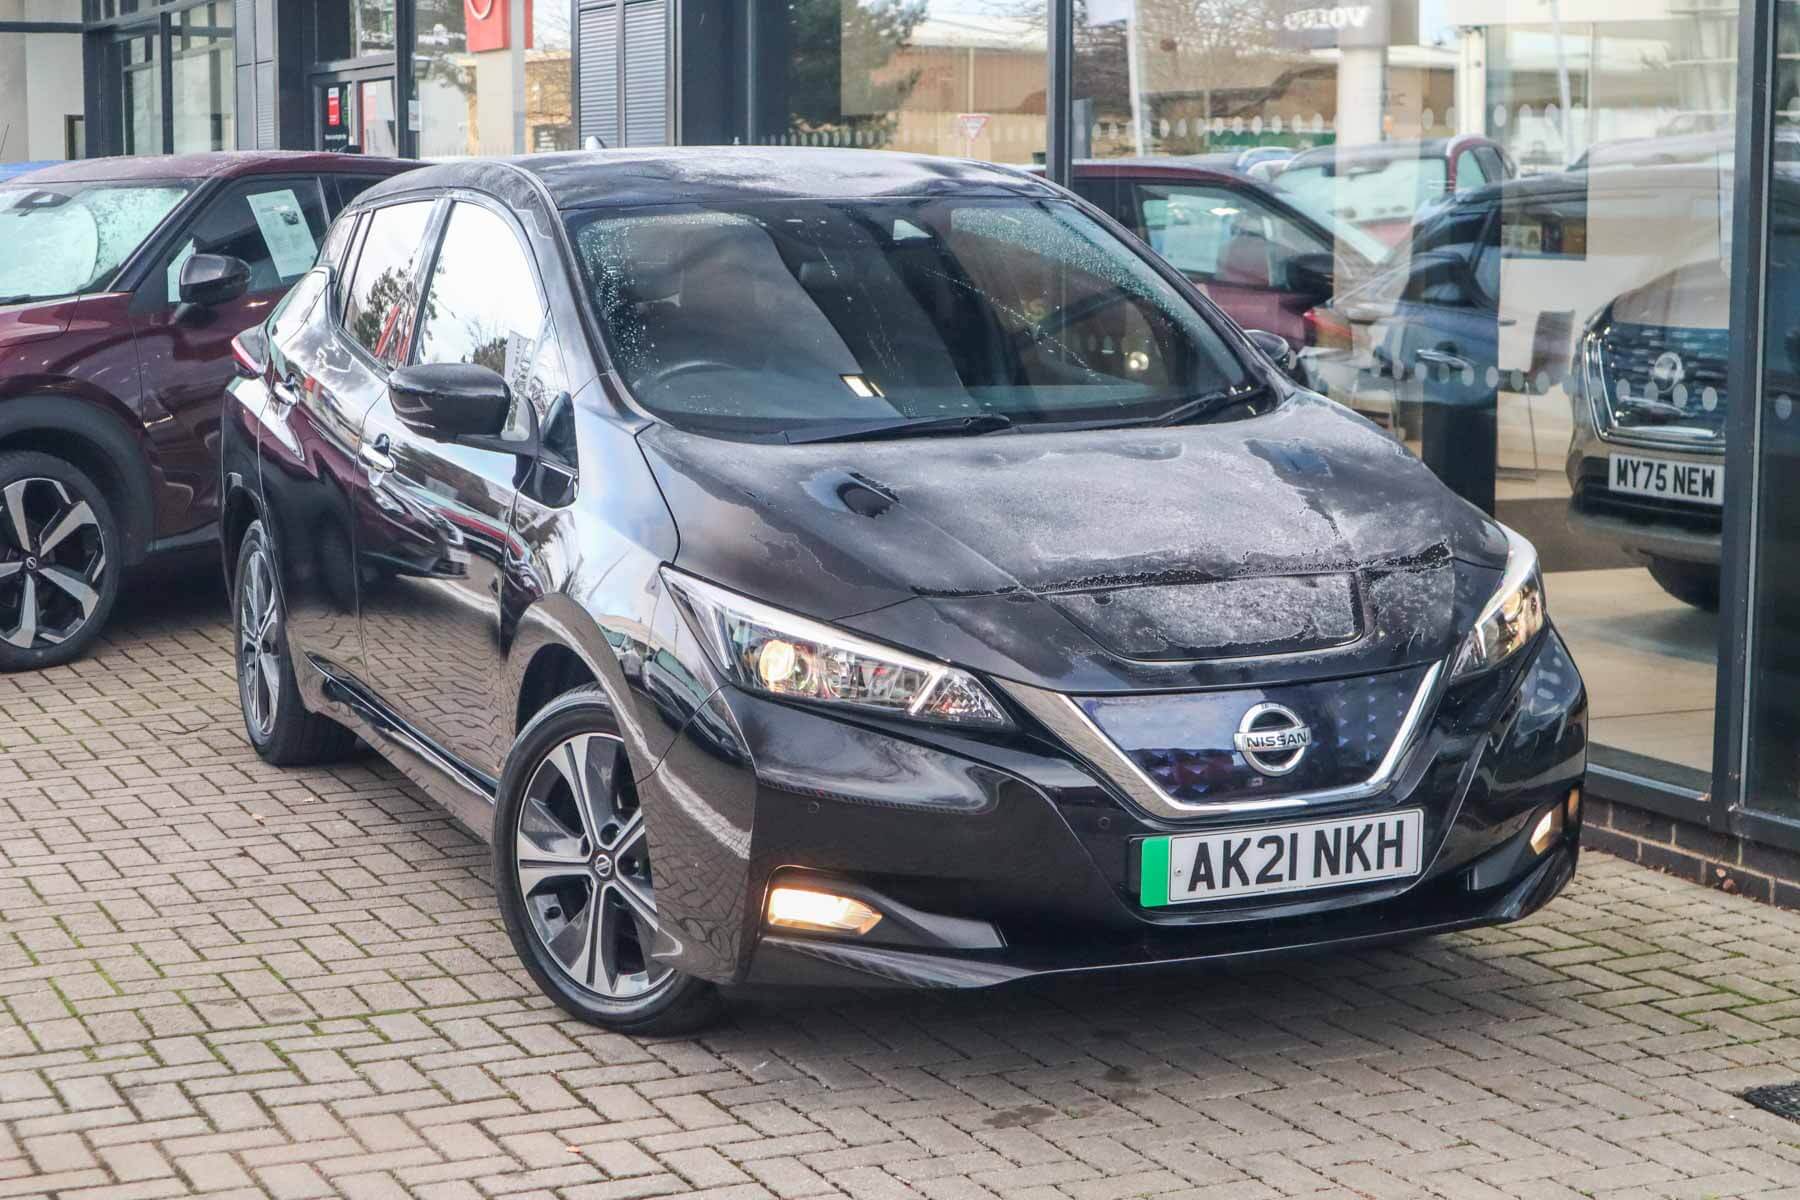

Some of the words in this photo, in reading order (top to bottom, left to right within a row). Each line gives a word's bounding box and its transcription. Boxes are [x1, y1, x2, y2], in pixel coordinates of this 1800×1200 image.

[1616, 457, 1668, 492] MY75
[1673, 464, 1716, 499] NEW
[1246, 731, 1307, 748] NISSAN
[1187, 832, 1299, 892] AK21
[1312, 819, 1405, 878] NKH
